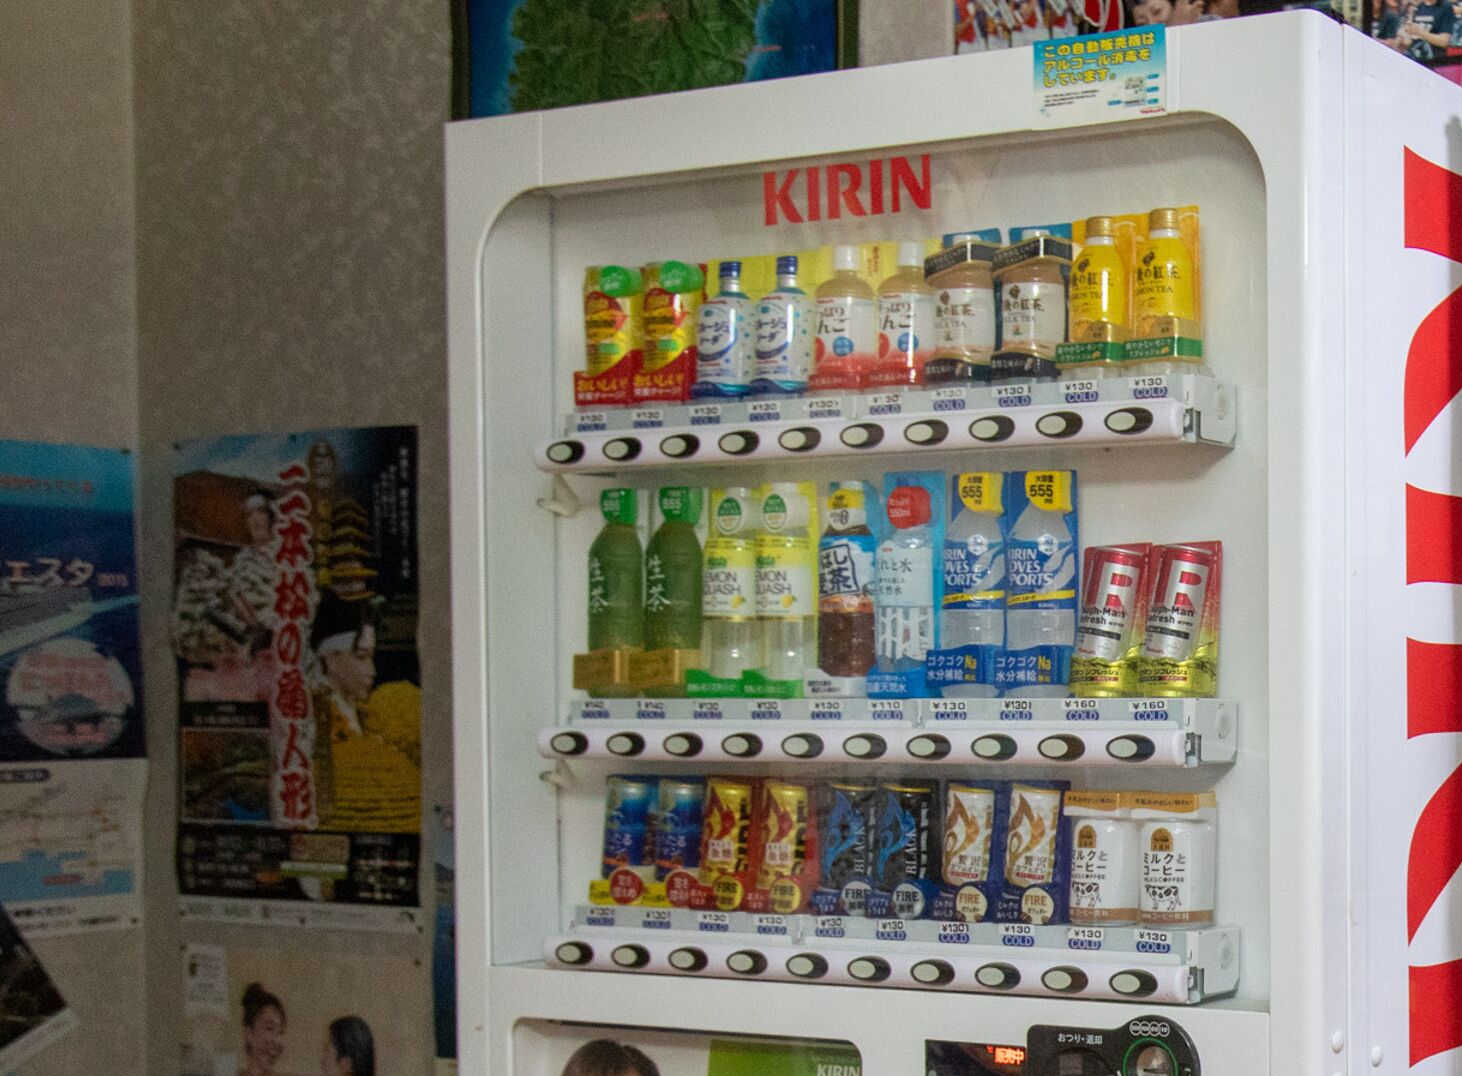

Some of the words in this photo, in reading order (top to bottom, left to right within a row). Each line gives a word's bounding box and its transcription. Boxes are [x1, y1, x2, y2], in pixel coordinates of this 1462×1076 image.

[1044, 32, 1155, 59] この自動販売機は
[1043, 48, 1151, 73] アルコール消毒を
[1043, 67, 1117, 88] しています。
[762, 153, 933, 226] KIRIN
[961, 485, 983, 499] 555
[1029, 484, 1054, 498] 555
[275, 463, 315, 824] 二本松の菊人形
[996, 655, 1036, 668] ゴクゴク
[1037, 655, 1052, 669] Na
[995, 670, 1037, 683] 水分補給
[1064, 699, 1097, 710] ¥160
[1132, 701, 1165, 712] ¥160
[895, 890, 919, 902] FIRE
[959, 892, 980, 904] FIRE
[1024, 894, 1048, 906] FIRE
[1004, 924, 1031, 935] ¥130
[1074, 928, 1101, 939] ¥130
[1139, 931, 1167, 942] ¥130
[1057, 1031, 1104, 1046] おつり・返却
[993, 1046, 1026, 1066] 販売中
